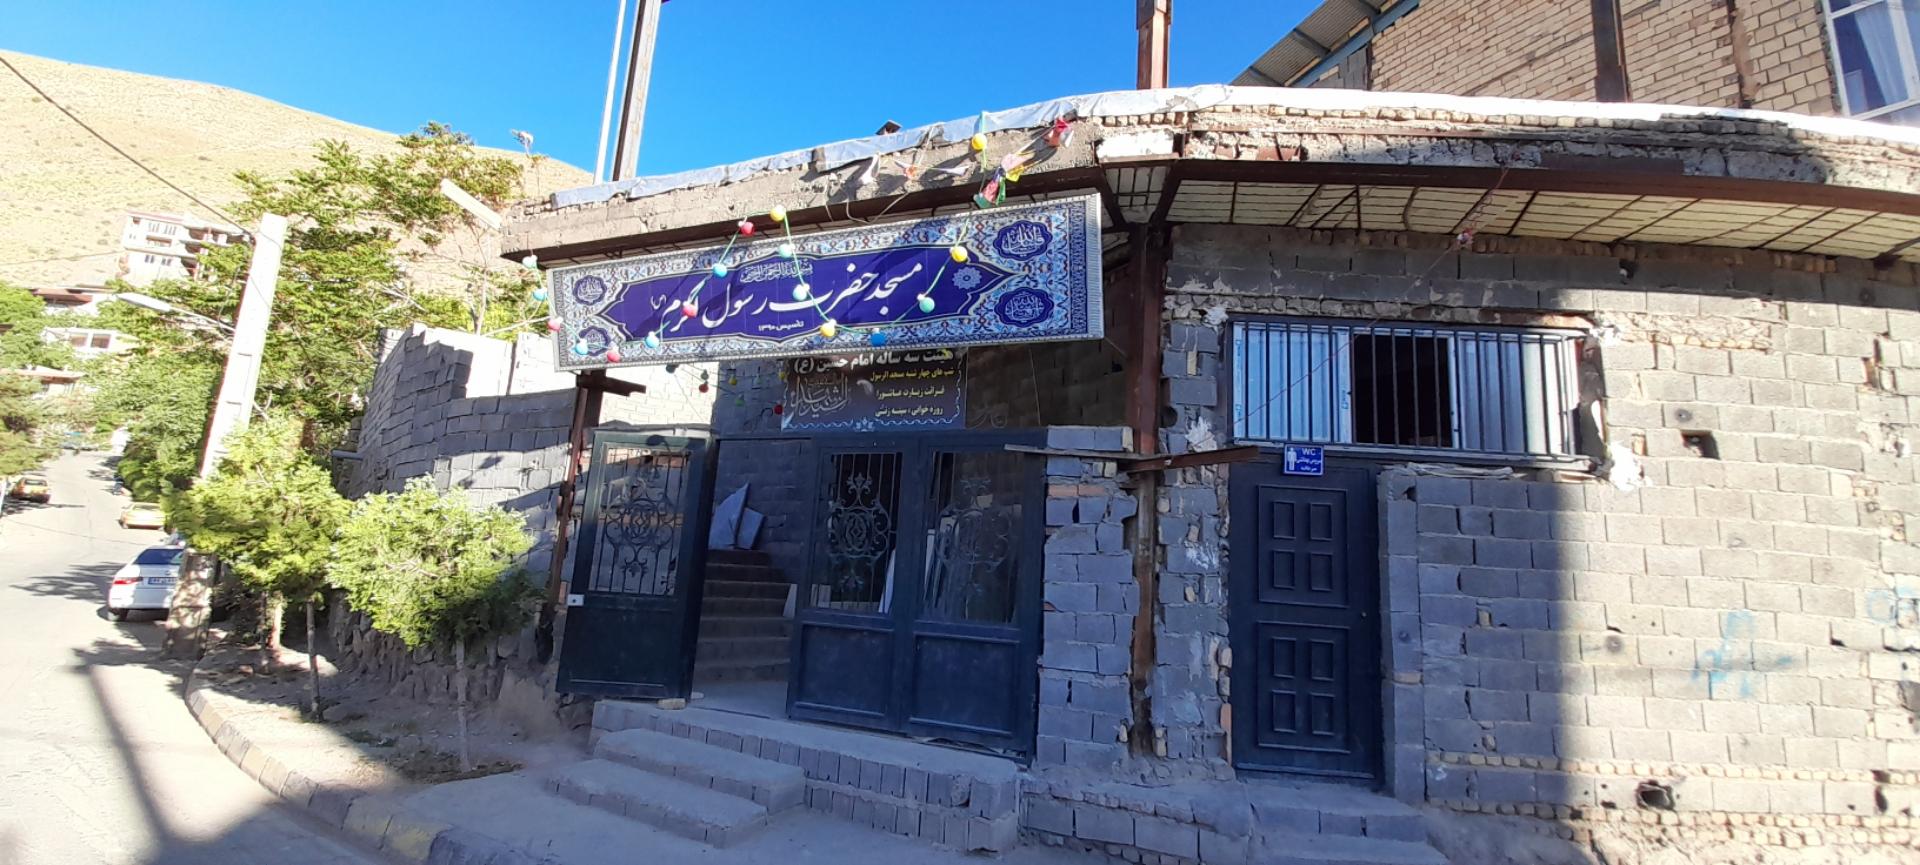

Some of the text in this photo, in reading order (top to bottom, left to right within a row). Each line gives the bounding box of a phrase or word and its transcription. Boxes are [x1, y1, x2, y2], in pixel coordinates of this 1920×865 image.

[768, 262, 880, 314] حضرت
[863, 262, 923, 316] مسجد
[702, 282, 768, 329] رسول
[817, 356, 849, 372] حسین
[850, 352, 874, 370] امام
[876, 351, 900, 365] ساله
[904, 353, 920, 364] سه
[794, 357, 814, 374] (ع)
[931, 367, 943, 378] های
[889, 370, 905, 379] مسجد
[876, 388, 902, 400] عاشورا
[903, 387, 924, 398] زیارت
[1301, 447, 1316, 456] WC
